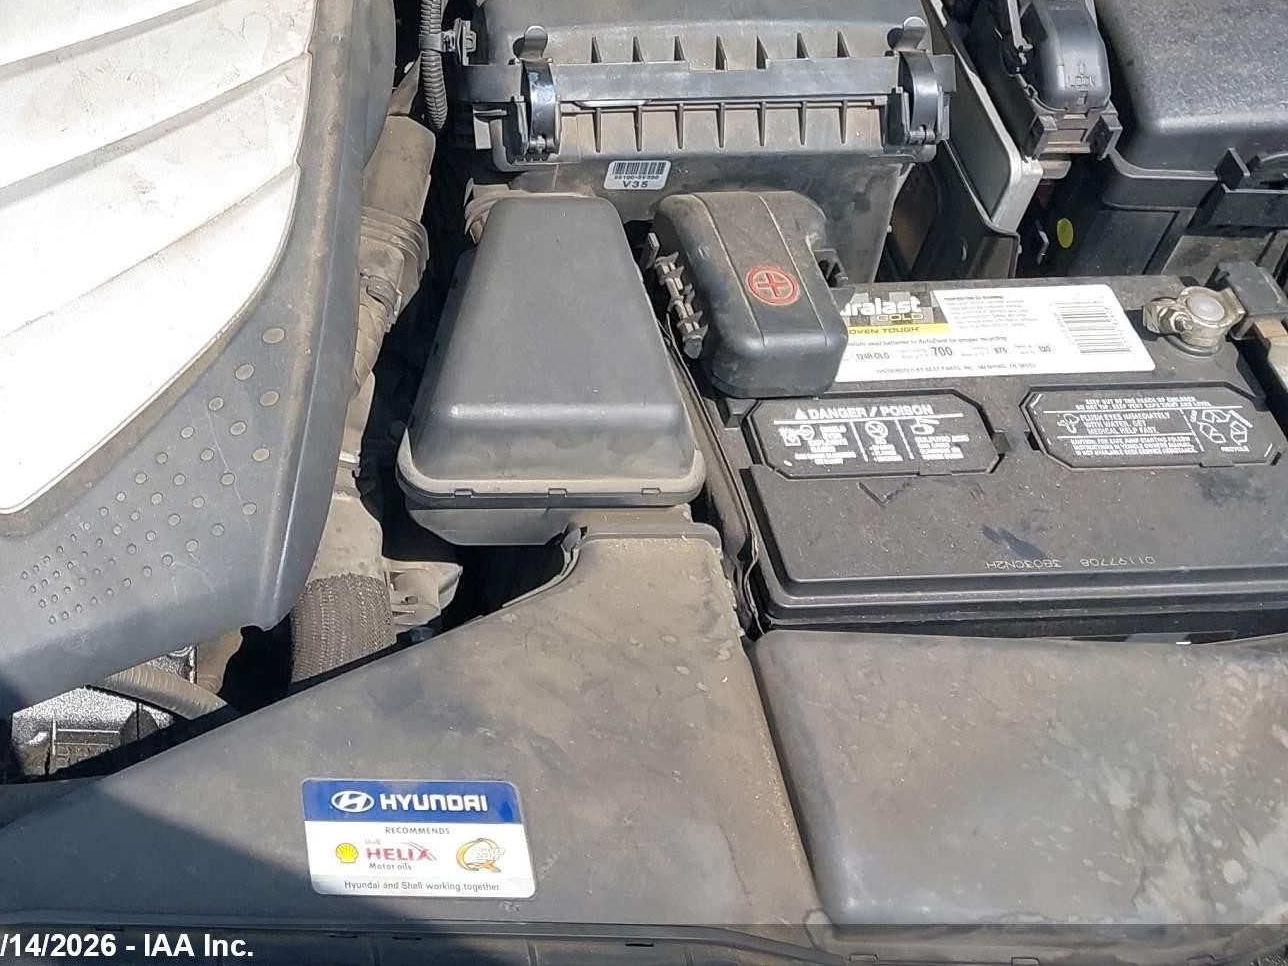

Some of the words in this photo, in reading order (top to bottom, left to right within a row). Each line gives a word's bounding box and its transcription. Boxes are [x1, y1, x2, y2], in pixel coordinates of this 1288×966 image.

[840, 296, 921, 316] uralast
[877, 313, 924, 321] GOLD
[931, 347, 953, 357] 700
[808, 406, 867, 420] DANGER
[879, 404, 934, 417] POISON
[1124, 412, 1171, 420] IMMEDIATELY
[380, 793, 488, 812] HYUNDAI
[385, 826, 450, 835] RECOMMENDS
[366, 848, 434, 861] HELIX
[369, 862, 395, 870] Motor
[397, 862, 412, 870] oils
[344, 880, 380, 890] Hyundai
[401, 881, 423, 890] Shell
[426, 882, 461, 892] working
[463, 882, 500, 892] together
